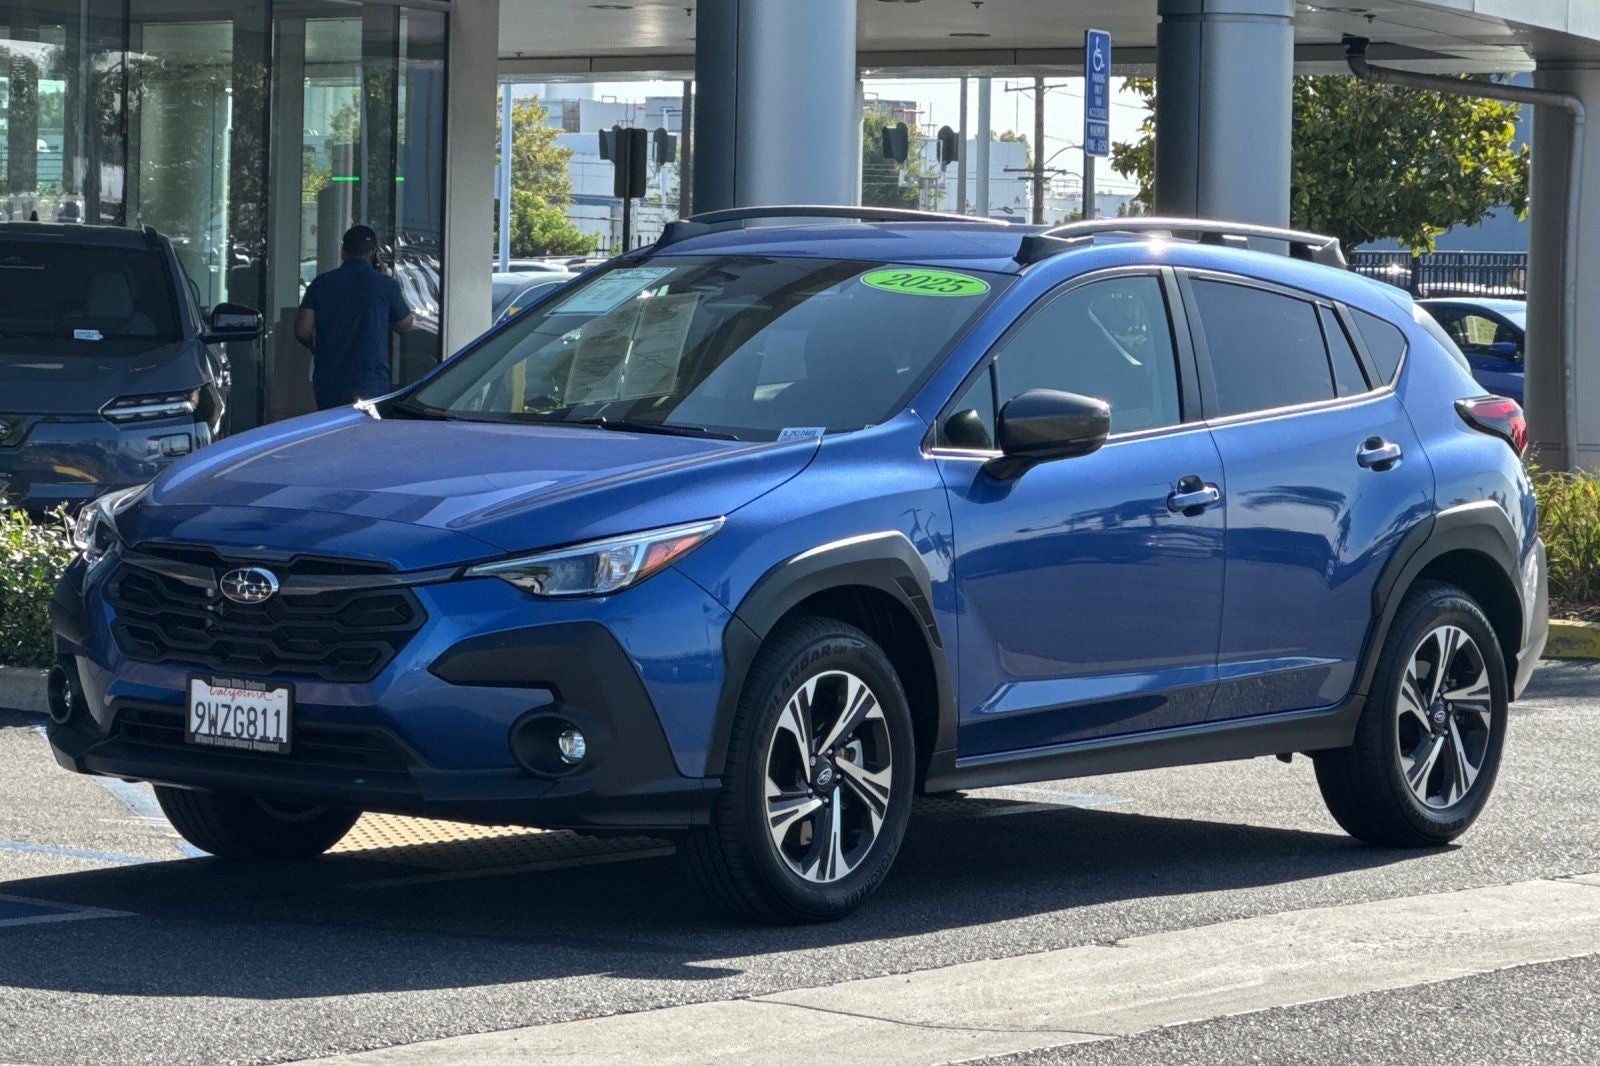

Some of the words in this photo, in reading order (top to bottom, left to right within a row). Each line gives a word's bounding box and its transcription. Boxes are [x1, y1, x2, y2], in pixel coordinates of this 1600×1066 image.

[876, 273, 975, 293] 2025
[209, 687, 272, 701] California
[195, 701, 283, 741] 9WZG811
